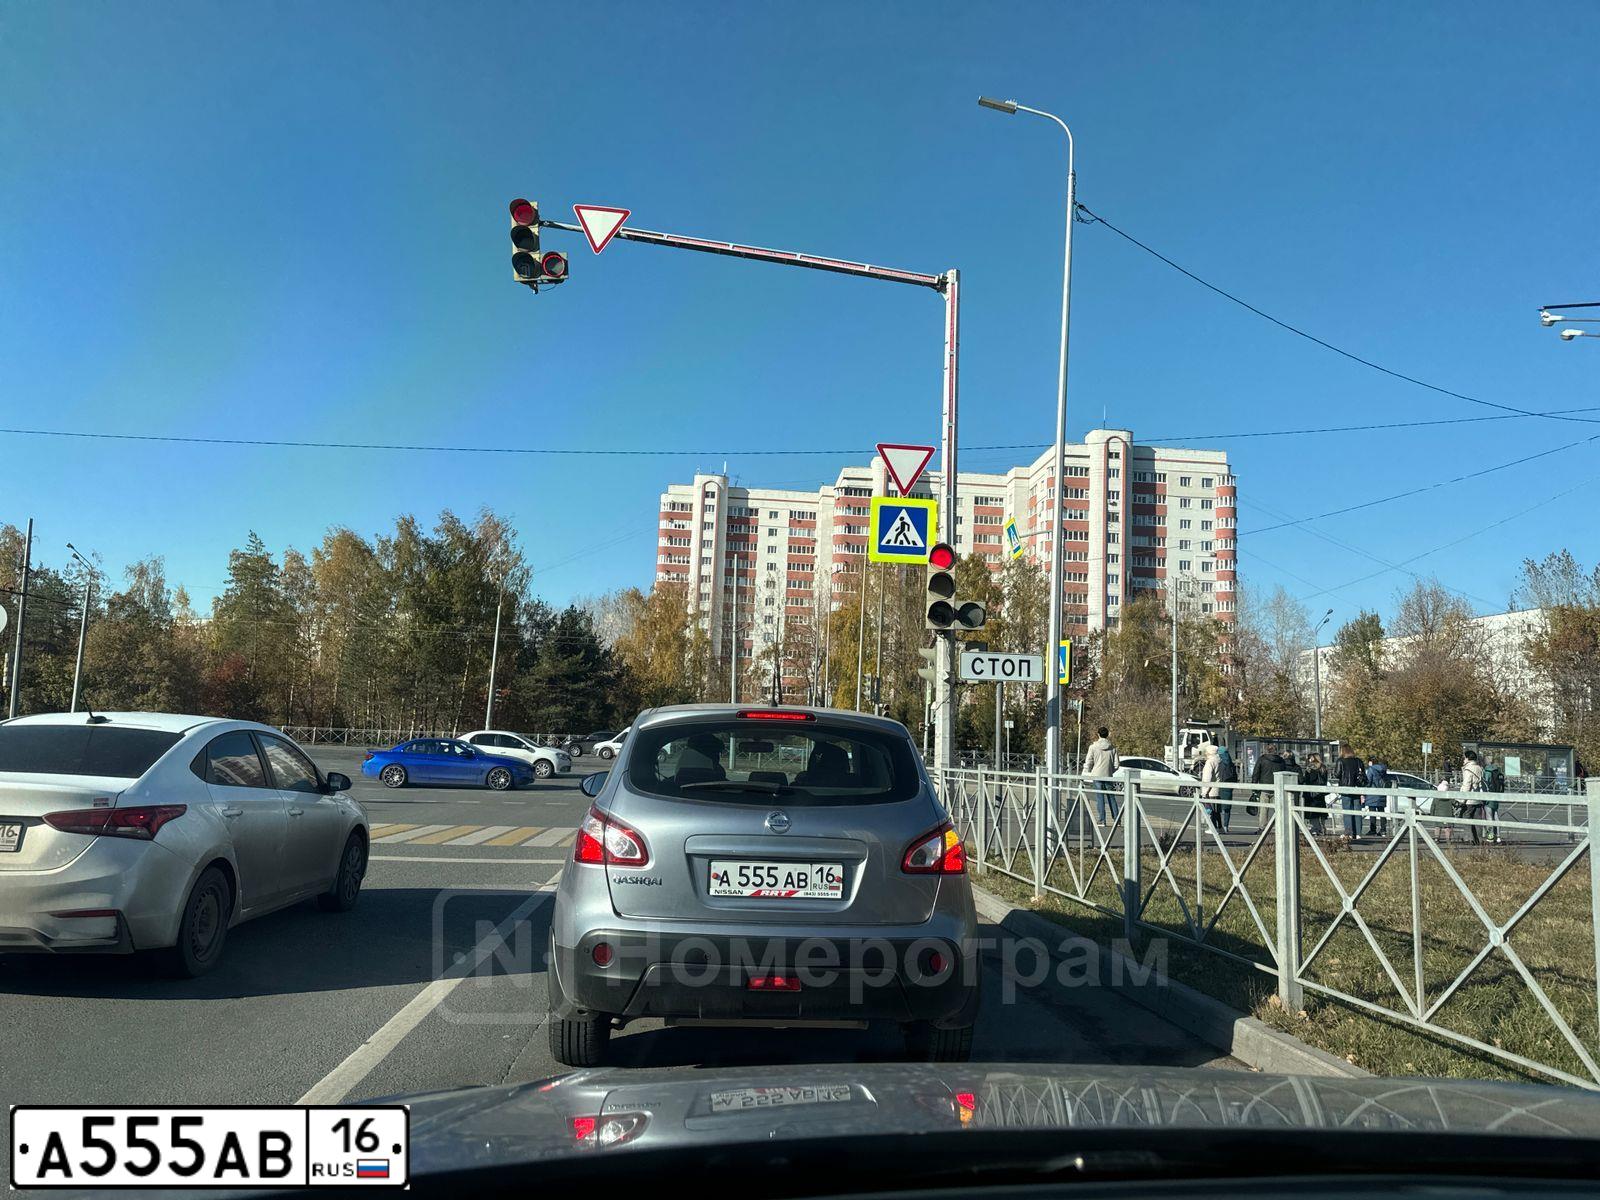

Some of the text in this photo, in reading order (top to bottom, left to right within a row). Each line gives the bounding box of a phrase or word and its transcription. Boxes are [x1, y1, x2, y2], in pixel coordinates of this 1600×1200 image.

[971, 657, 1031, 677] СТОП
[613, 873, 663, 886] QASHQAI
[737, 865, 779, 888] 555
[815, 866, 835, 883] 16
